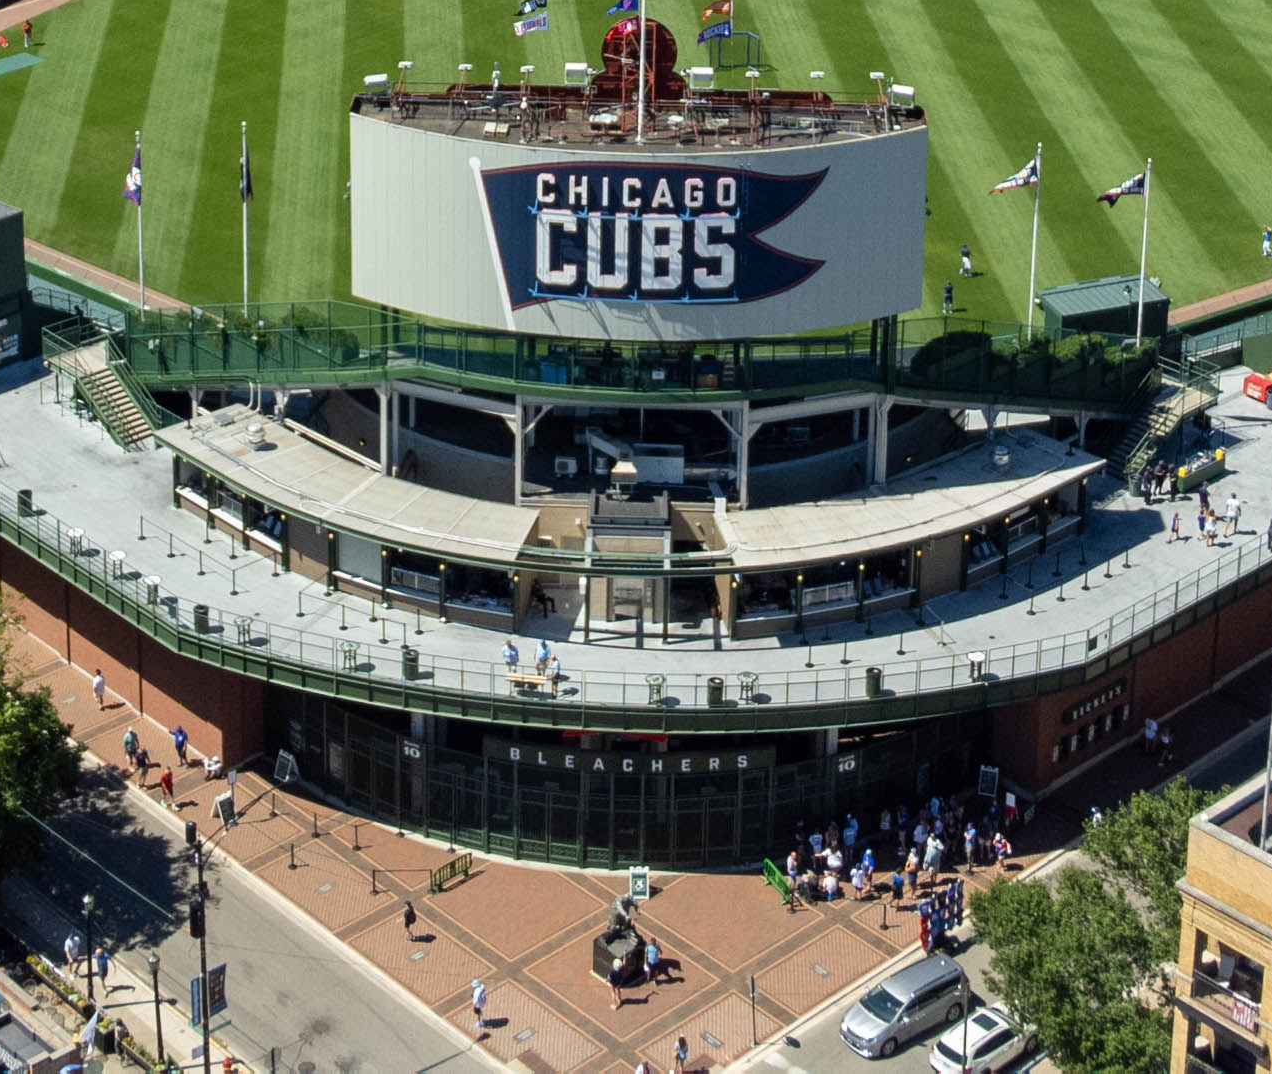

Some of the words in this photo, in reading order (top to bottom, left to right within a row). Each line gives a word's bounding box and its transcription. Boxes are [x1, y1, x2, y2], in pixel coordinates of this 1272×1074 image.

[536, 172, 737, 208] CHICAGO
[536, 208, 736, 291] CUBS
[403, 746, 421, 759] 10
[510, 747, 748, 773] BLEACHERS
[838, 760, 855, 773] 10
